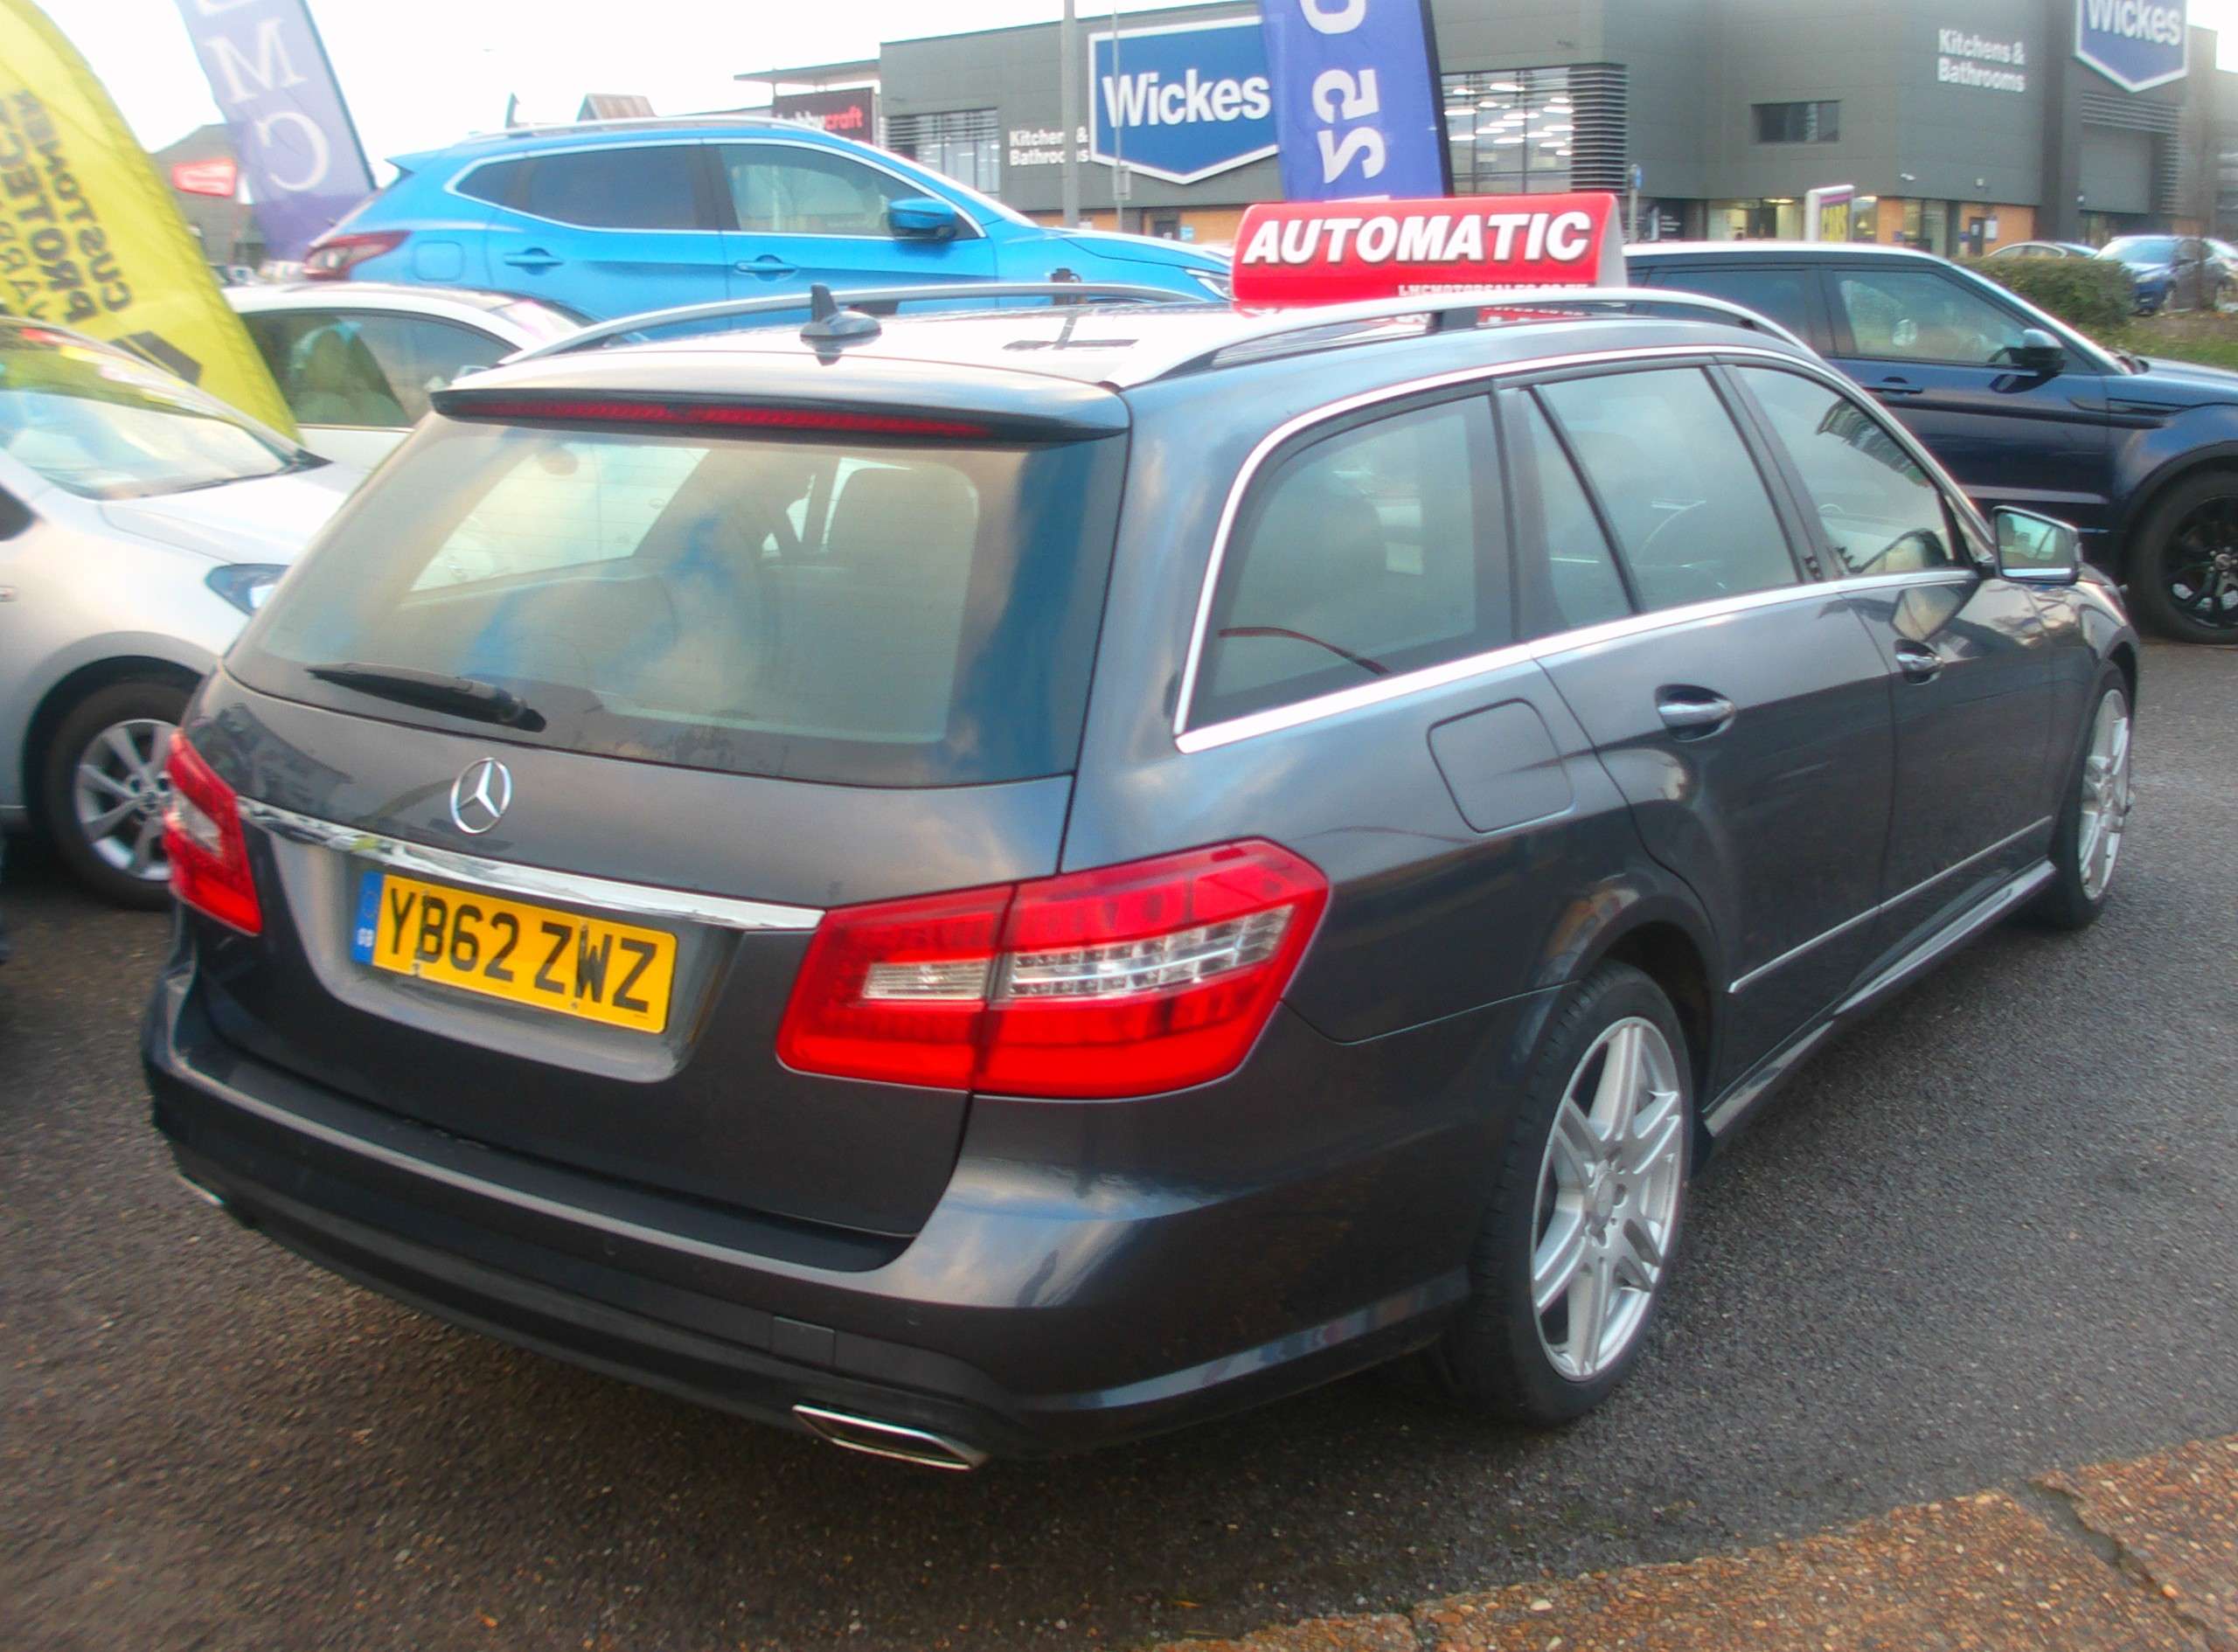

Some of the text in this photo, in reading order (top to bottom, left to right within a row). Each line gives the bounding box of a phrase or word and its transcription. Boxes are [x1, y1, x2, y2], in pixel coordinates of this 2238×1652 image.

[2087, 0, 2183, 47] Wickes
[1937, 28, 2025, 66] Kitchens &
[1937, 56, 2026, 93] Bathrooms
[1102, 68, 1272, 128] Wickes
[1009, 126, 1088, 147] Kitchen &
[1009, 149, 1089, 166] Bathroos
[1241, 211, 1591, 264] AUTOMATIC
[388, 886, 657, 1014] YB62 ZWZ
